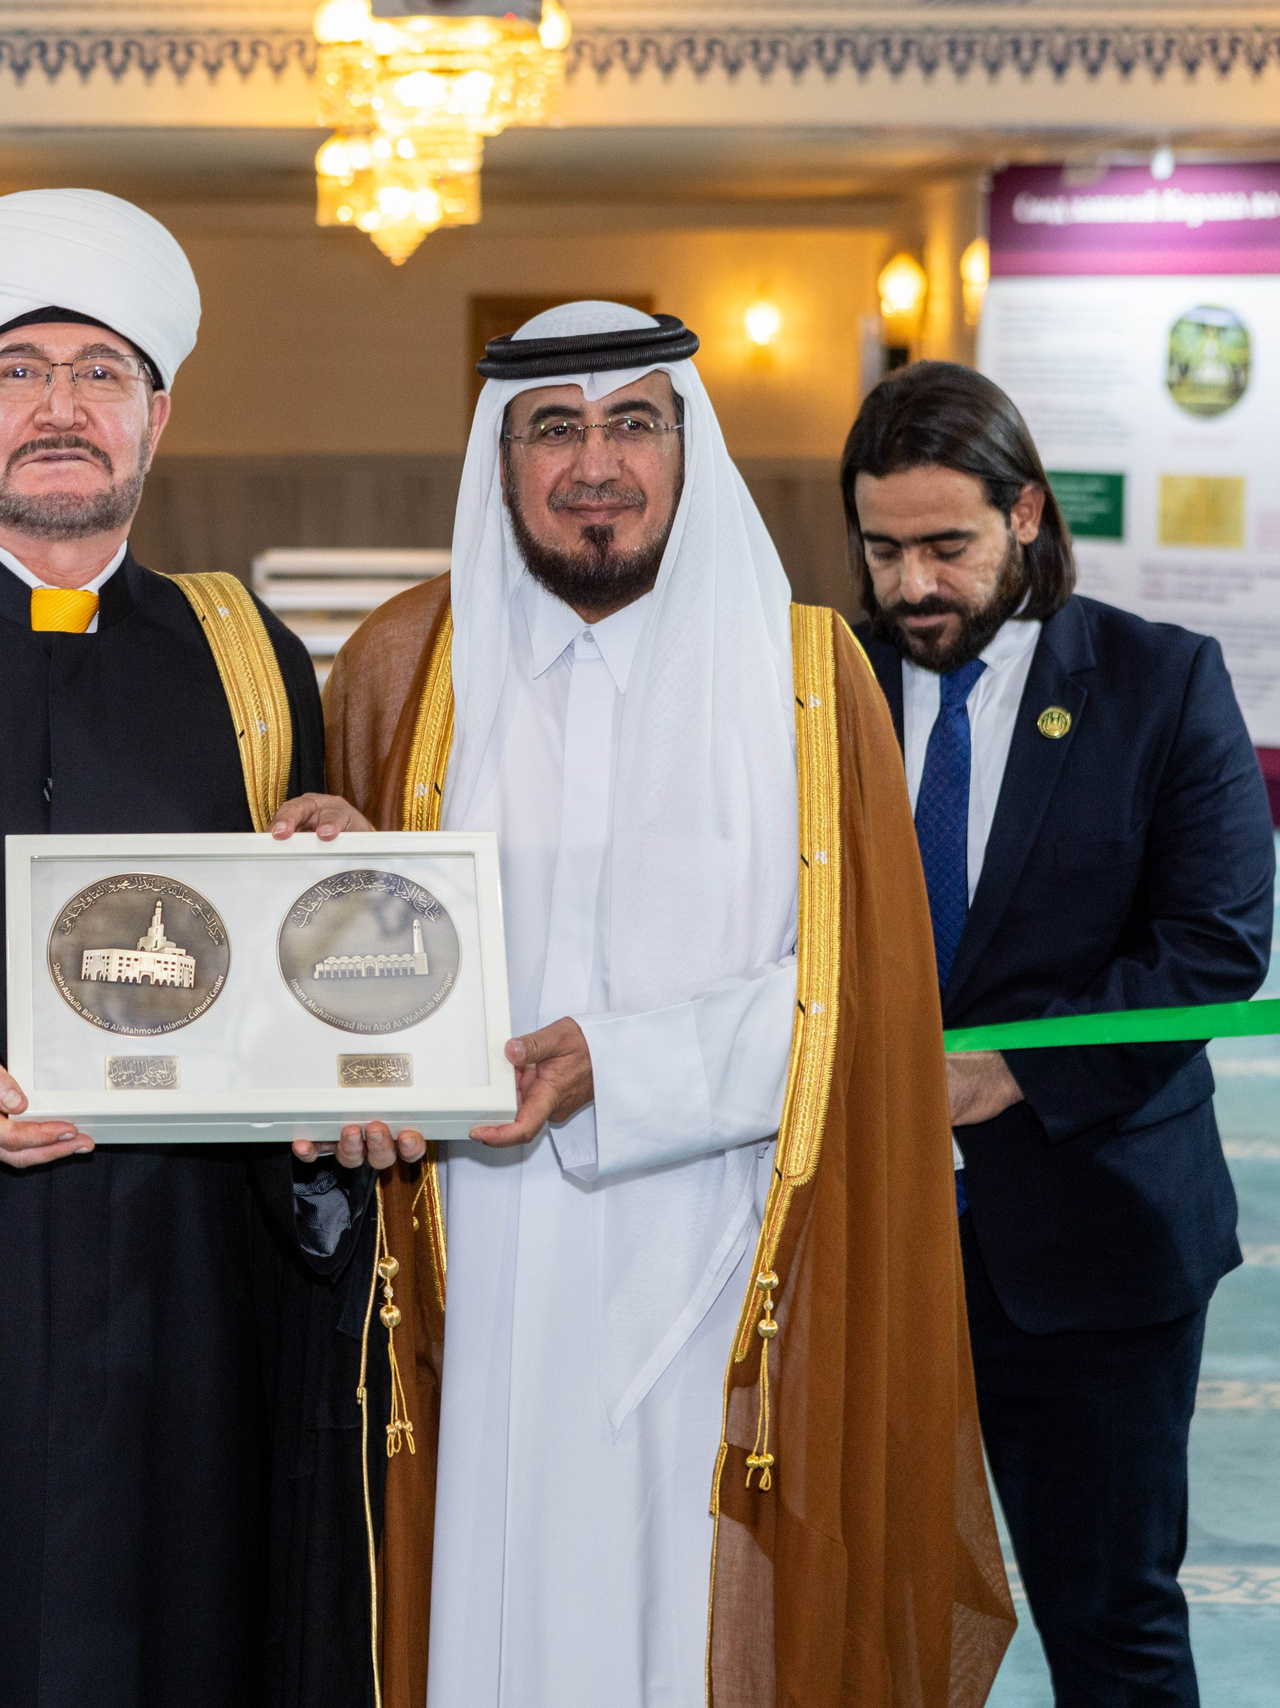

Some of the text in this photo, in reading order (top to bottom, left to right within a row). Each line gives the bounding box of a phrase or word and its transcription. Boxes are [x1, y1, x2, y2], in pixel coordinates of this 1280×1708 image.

[52, 962, 226, 1036] Sheikh Abdulla Bin Zaid Al-Mahmoud Islamic Cultural Center
[289, 971, 455, 1032] Imam Muhammad Ibn Abd Al-Wahhab Mosque
